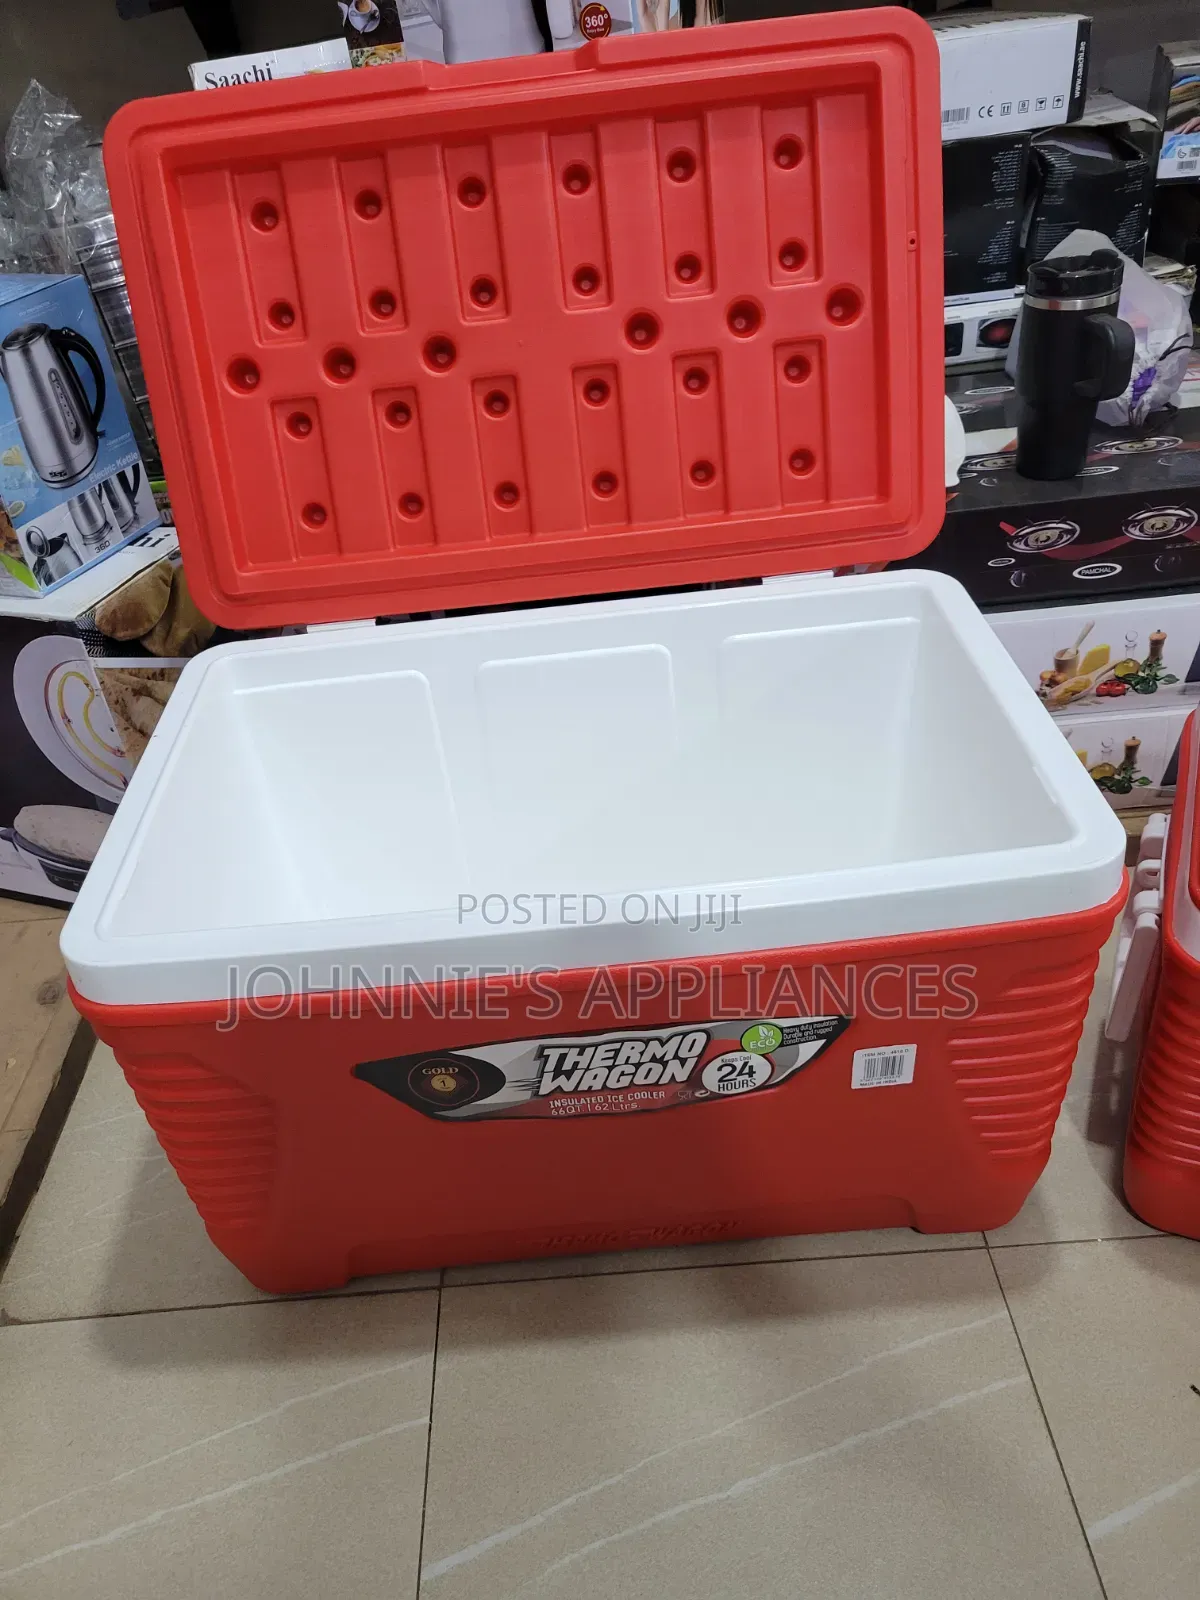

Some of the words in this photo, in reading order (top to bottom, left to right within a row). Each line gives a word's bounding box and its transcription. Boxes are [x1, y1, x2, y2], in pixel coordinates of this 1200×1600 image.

[1074, 41, 1087, 98] www.saachi.ae
[88, 463, 117, 483] Electric
[115, 451, 139, 467] Kettle
[783, 1031, 803, 1040] Durable
[814, 1025, 833, 1034] rugged
[543, 1031, 707, 1072] THERMO
[750, 1038, 775, 1048] ECO
[422, 1067, 458, 1075] GOLD
[538, 1057, 698, 1095] WAGON
[717, 1061, 756, 1083] 24
[717, 1078, 757, 1092] HOURS
[549, 1096, 603, 1108] INSULATED
[608, 1094, 624, 1103] ICE
[627, 1091, 666, 1101] COOLER
[595, 1102, 609, 1111] 62
